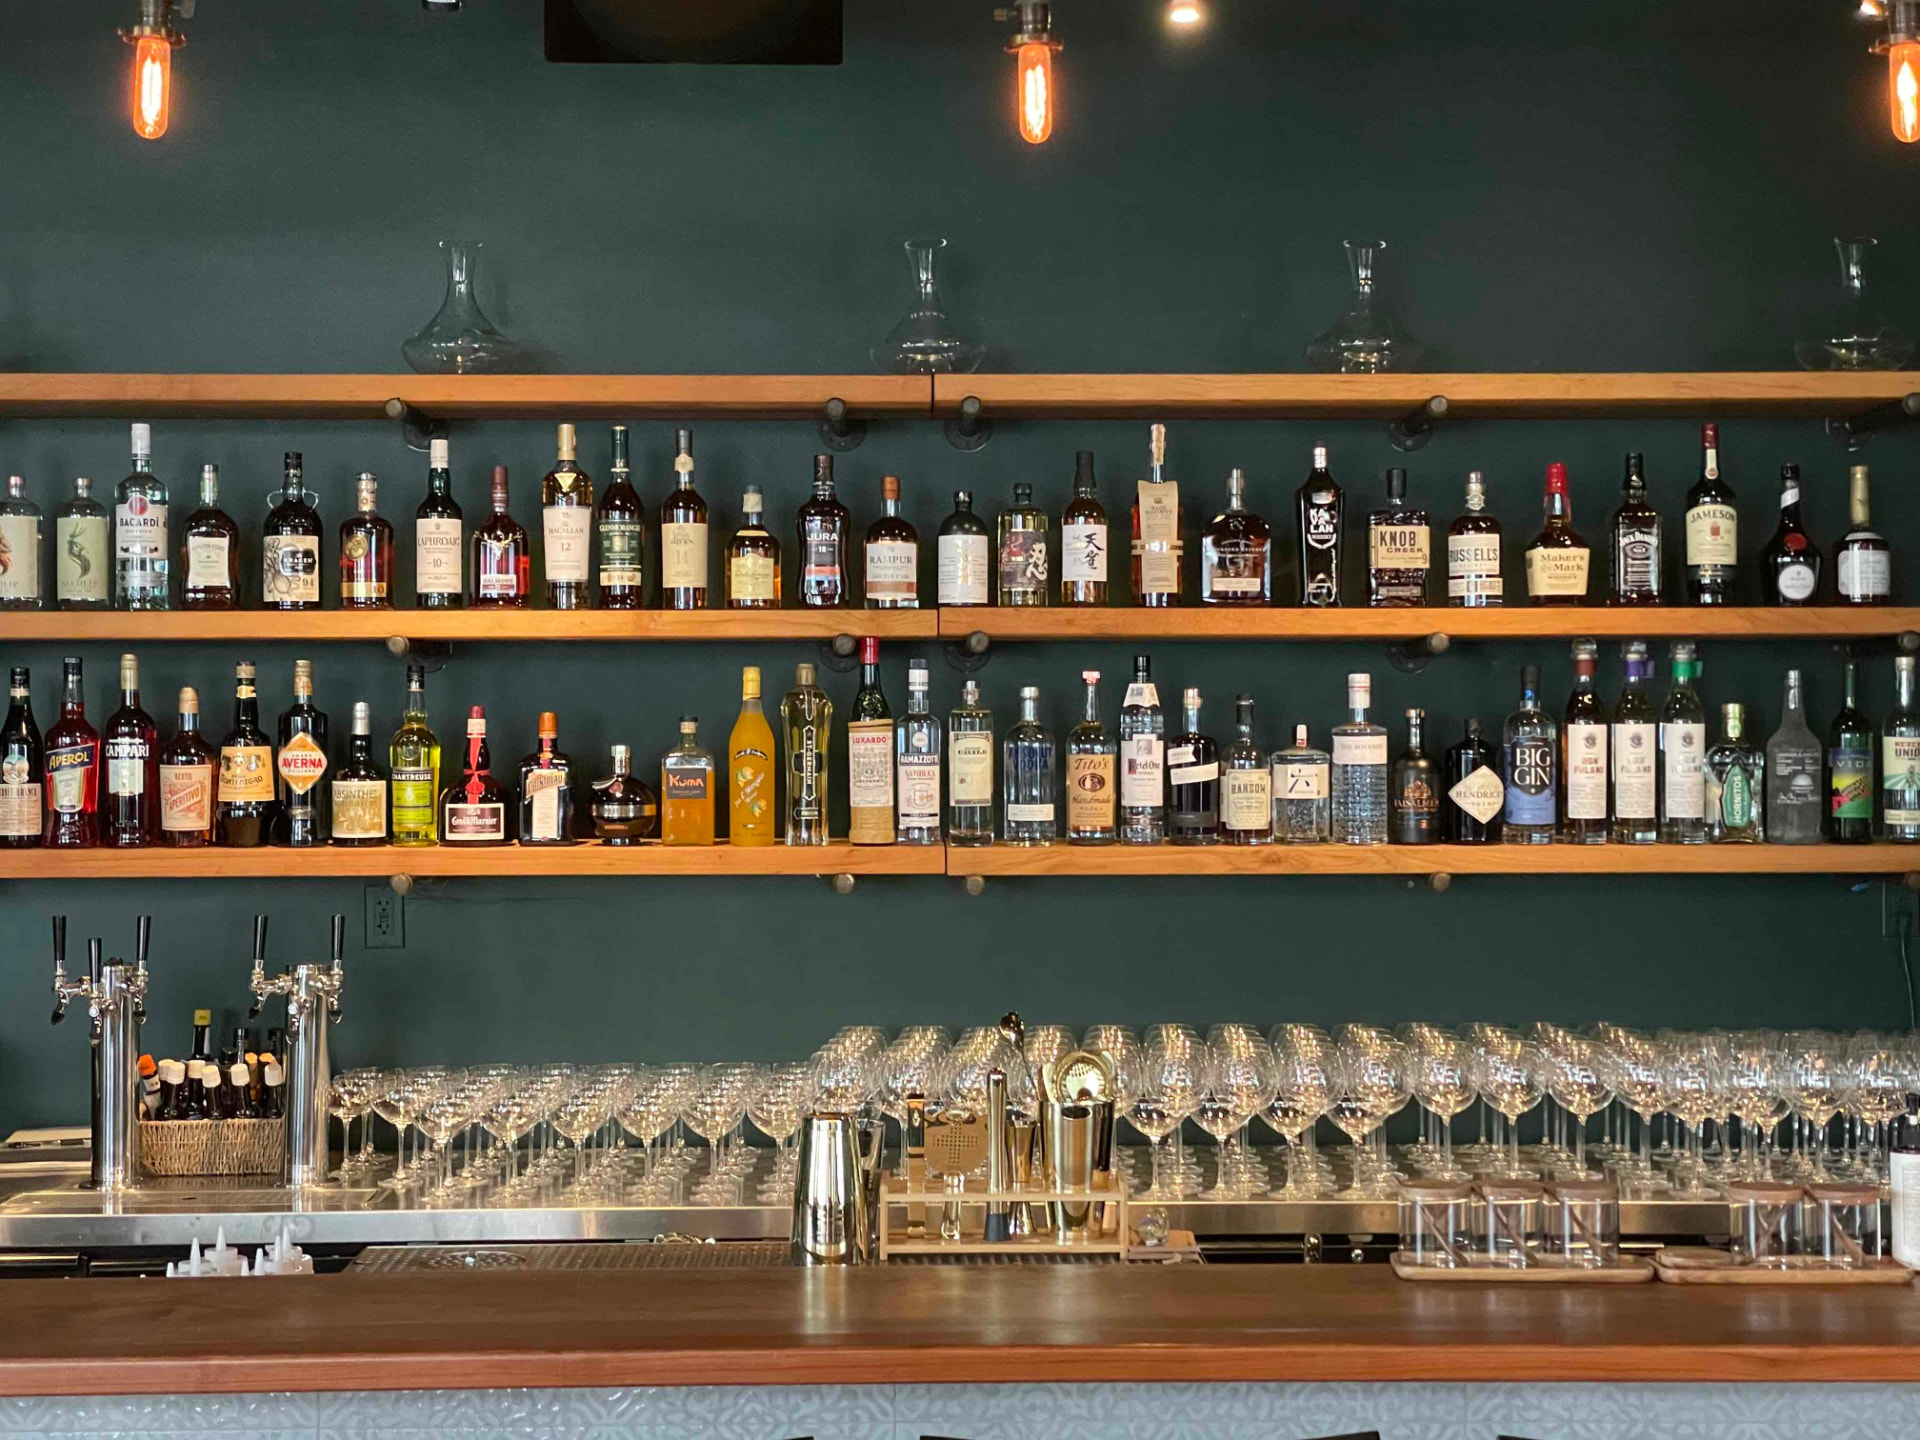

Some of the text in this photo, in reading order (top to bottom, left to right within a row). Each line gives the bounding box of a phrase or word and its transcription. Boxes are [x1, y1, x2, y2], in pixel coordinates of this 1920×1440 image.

[118, 516, 160, 528] BACARDÍ
[1690, 508, 1737, 524] JAMESON
[548, 527, 585, 535] MACALLAN
[417, 537, 460, 549] LAPHROAIG
[806, 533, 839, 542] JURA
[1379, 530, 1417, 547] KNOB
[561, 542, 572, 553] 12
[869, 555, 913, 565] RAMPUR
[1421, 553, 1428, 565] 9
[1448, 548, 1499, 563] RUSSELL'S
[1540, 553, 1585, 564] Maker's
[433, 558, 443, 568] 10
[1553, 562, 1585, 572] Mark
[853, 736, 887, 744] LUXARDO
[106, 744, 149, 757] CAMPARI
[1008, 747, 1053, 759] ABSOLUT
[1515, 747, 1551, 766] BIG
[49, 750, 90, 770] APEROL
[282, 758, 324, 769] AVERNA
[900, 754, 939, 764] RAMAZZOTTI
[1013, 759, 1049, 770] VODKA
[1074, 757, 1109, 771] Tito's
[1149, 760, 1161, 770] One
[391, 772, 432, 781] CHARTREUSE
[1513, 766, 1551, 786] GIN
[527, 775, 563, 794] COINTREAU
[1230, 783, 1267, 795] RANSOM
[169, 787, 200, 810] APERITIVO
[1071, 795, 1112, 804] Handmade
[1732, 775, 1743, 825] HORNITOS
